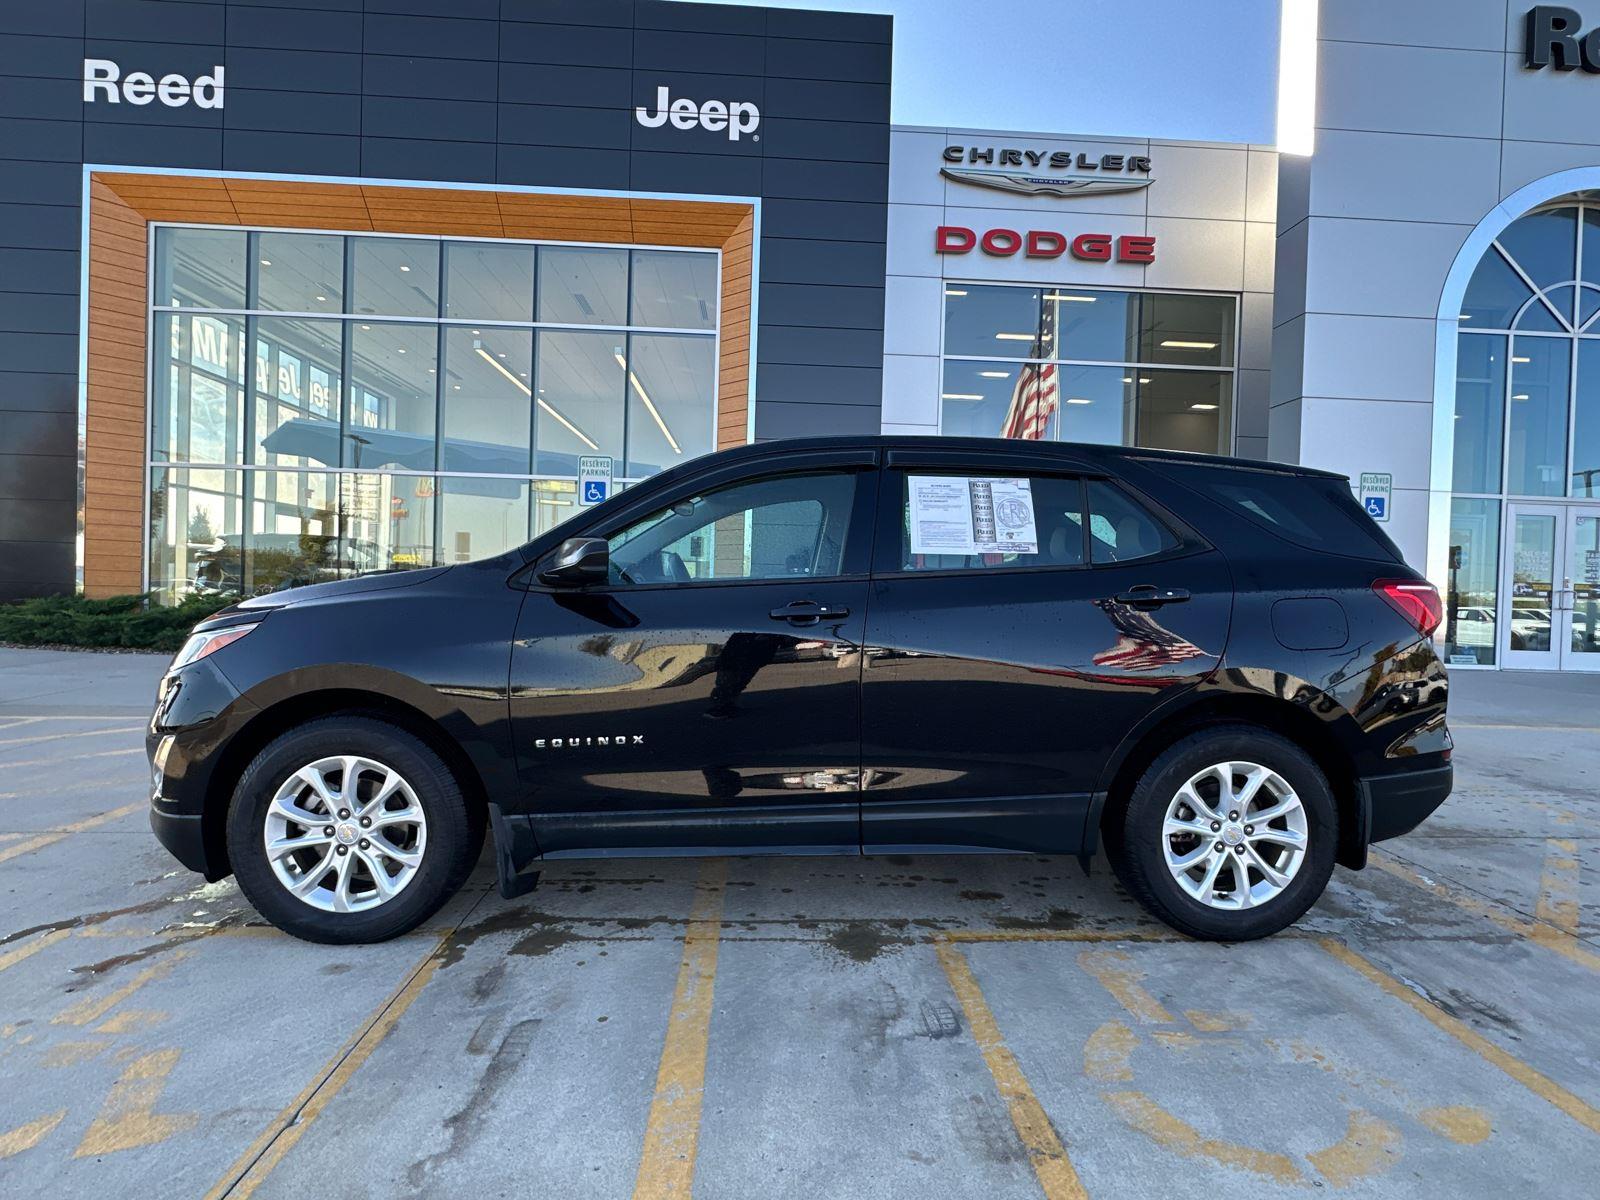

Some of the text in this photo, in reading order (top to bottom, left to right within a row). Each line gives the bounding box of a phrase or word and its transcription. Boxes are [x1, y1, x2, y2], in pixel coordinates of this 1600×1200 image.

[84, 59, 225, 109] Reed
[943, 146, 1152, 172] CHRYSLER
[936, 226, 1156, 263] DODGE
[581, 460, 610, 468] RESERVED
[1362, 485, 1389, 493] PARKING
[535, 735, 644, 748] EQUINOX
